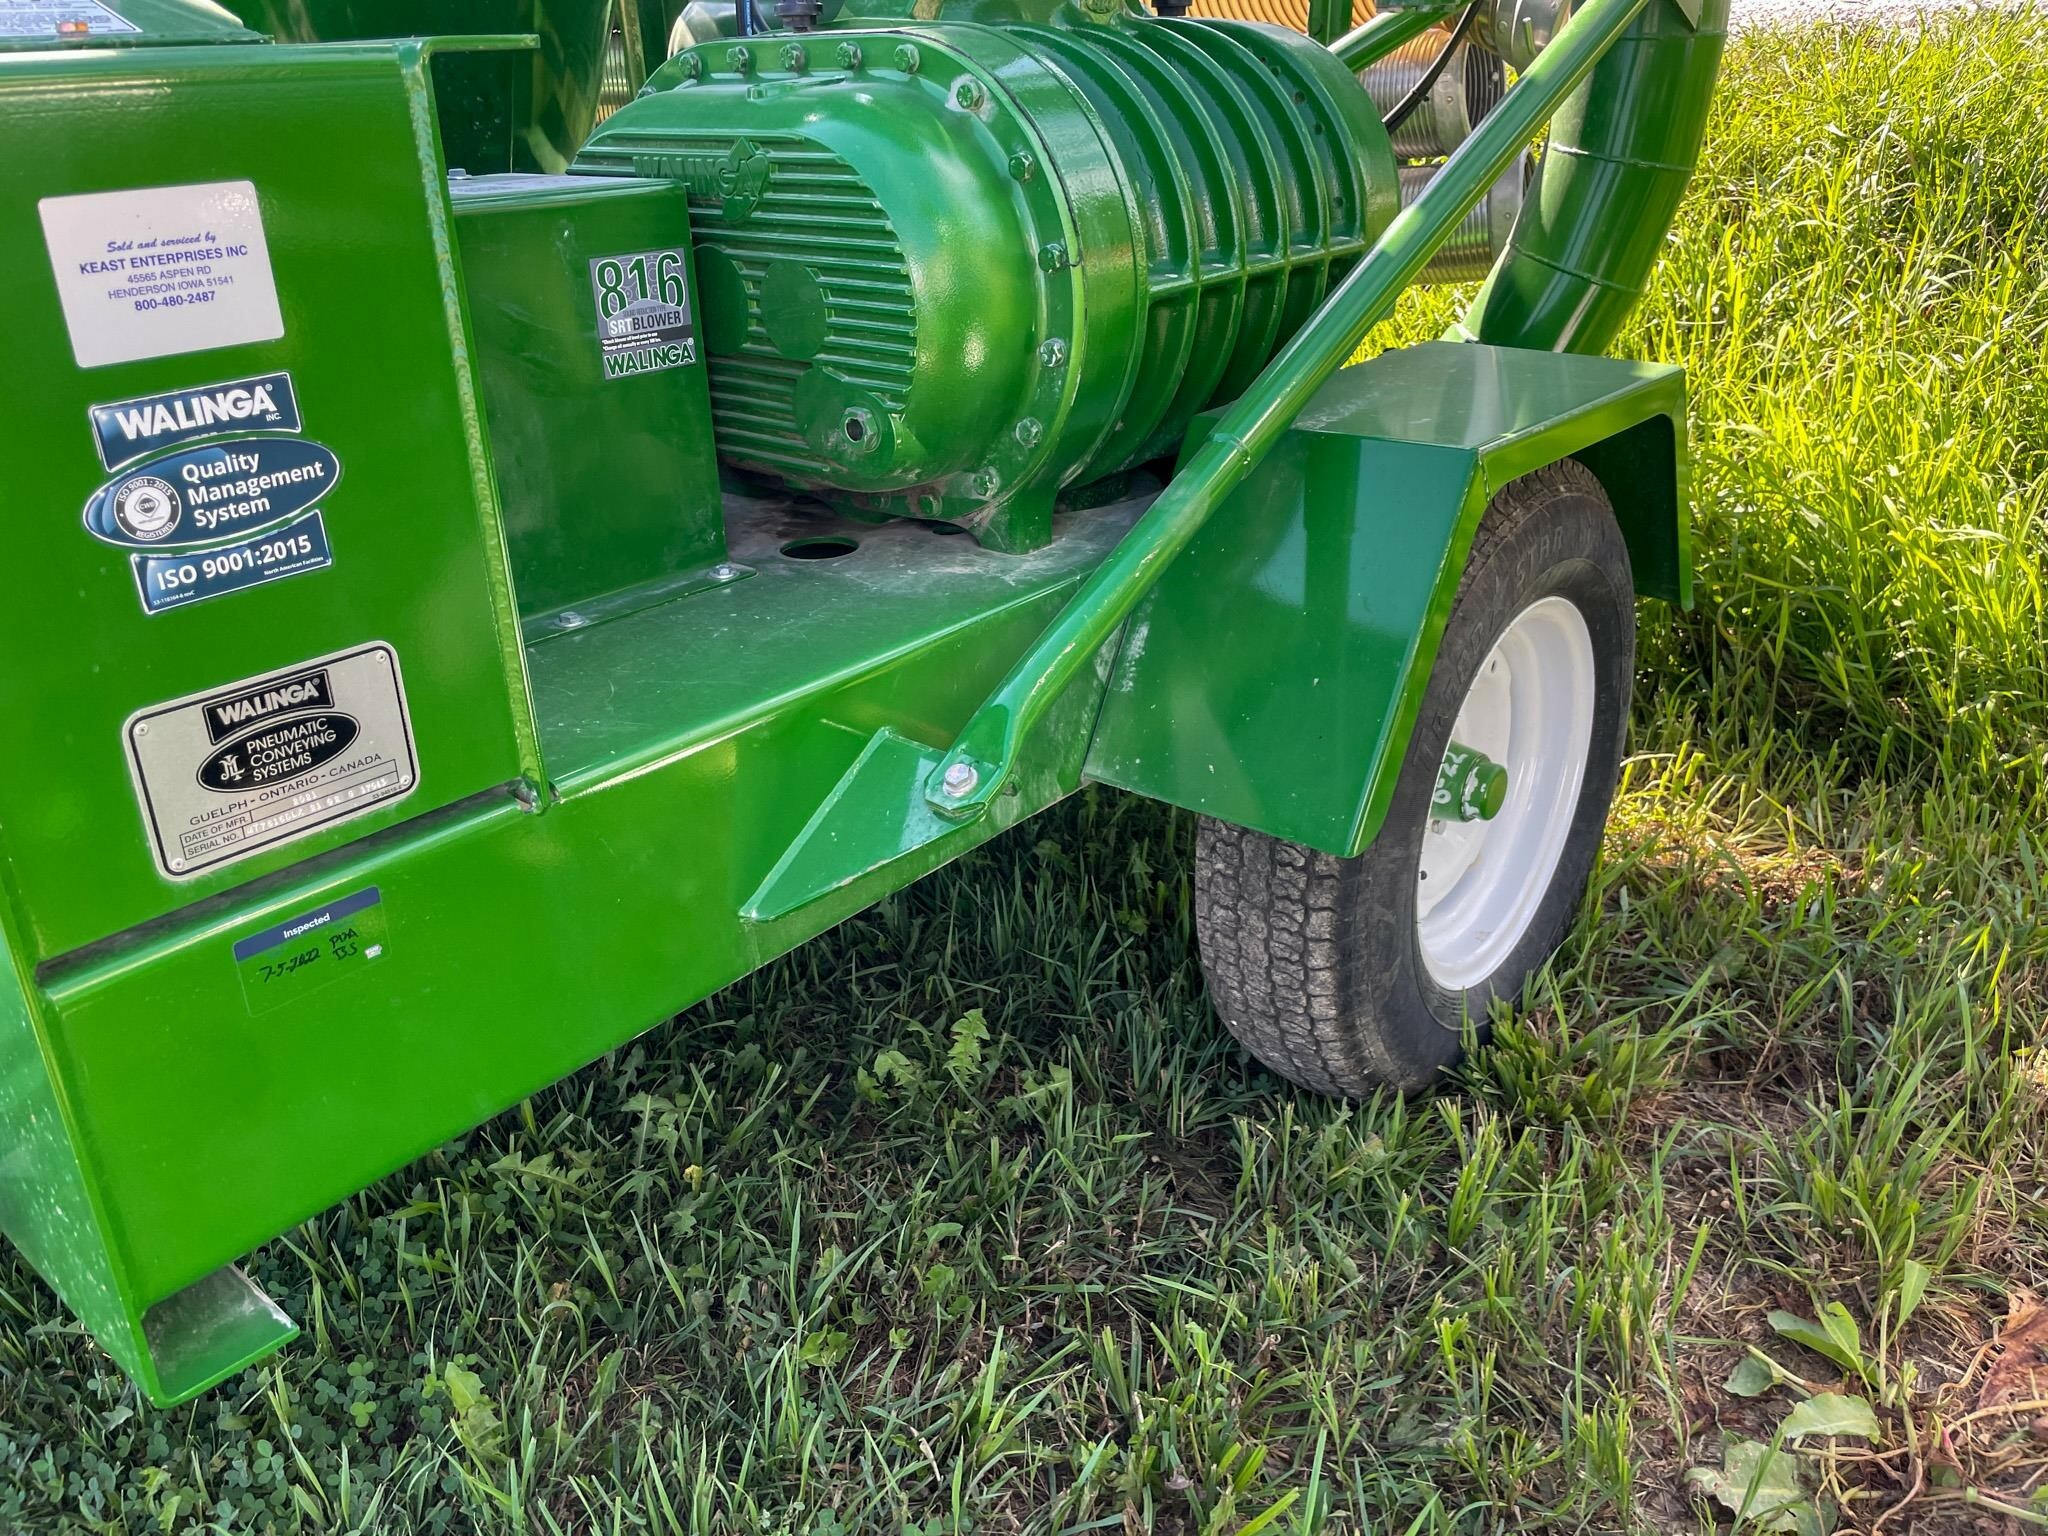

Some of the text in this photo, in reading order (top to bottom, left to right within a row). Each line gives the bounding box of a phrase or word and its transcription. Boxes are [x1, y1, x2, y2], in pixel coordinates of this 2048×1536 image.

[107, 231, 216, 253] Sold and serviced by
[79, 245, 248, 275] KEAST ENTERPRISES INC
[159, 267, 195, 280] ASPEN
[196, 265, 212, 275] RD
[108, 275, 234, 300] HENDERSON IOWA 51541
[134, 291, 216, 311] 800-480-2487
[595, 251, 686, 320] 816
[605, 342, 695, 376] WALINGA
[114, 385, 278, 440] WALINGA
[182, 453, 260, 484] Quality
[187, 461, 325, 506] Management
[193, 497, 271, 529] System
[135, 521, 174, 539] REGISTERED
[156, 534, 312, 591] ISO 9001:2015
[217, 680, 320, 725] WALINGA
[246, 718, 328, 754] PNEUMATIC
[250, 730, 337, 767] CONVEYING
[253, 752, 312, 781] SYSTEMS
[189, 799, 248, 825] GUELPH
[259, 775, 319, 801] ONTARIO
[329, 753, 382, 777] CANADA
[184, 829, 209, 844] DATE
[210, 824, 224, 834] OF
[187, 841, 221, 856] SERIAL
[222, 832, 240, 843] NO.
[283, 912, 331, 939] Inspected
